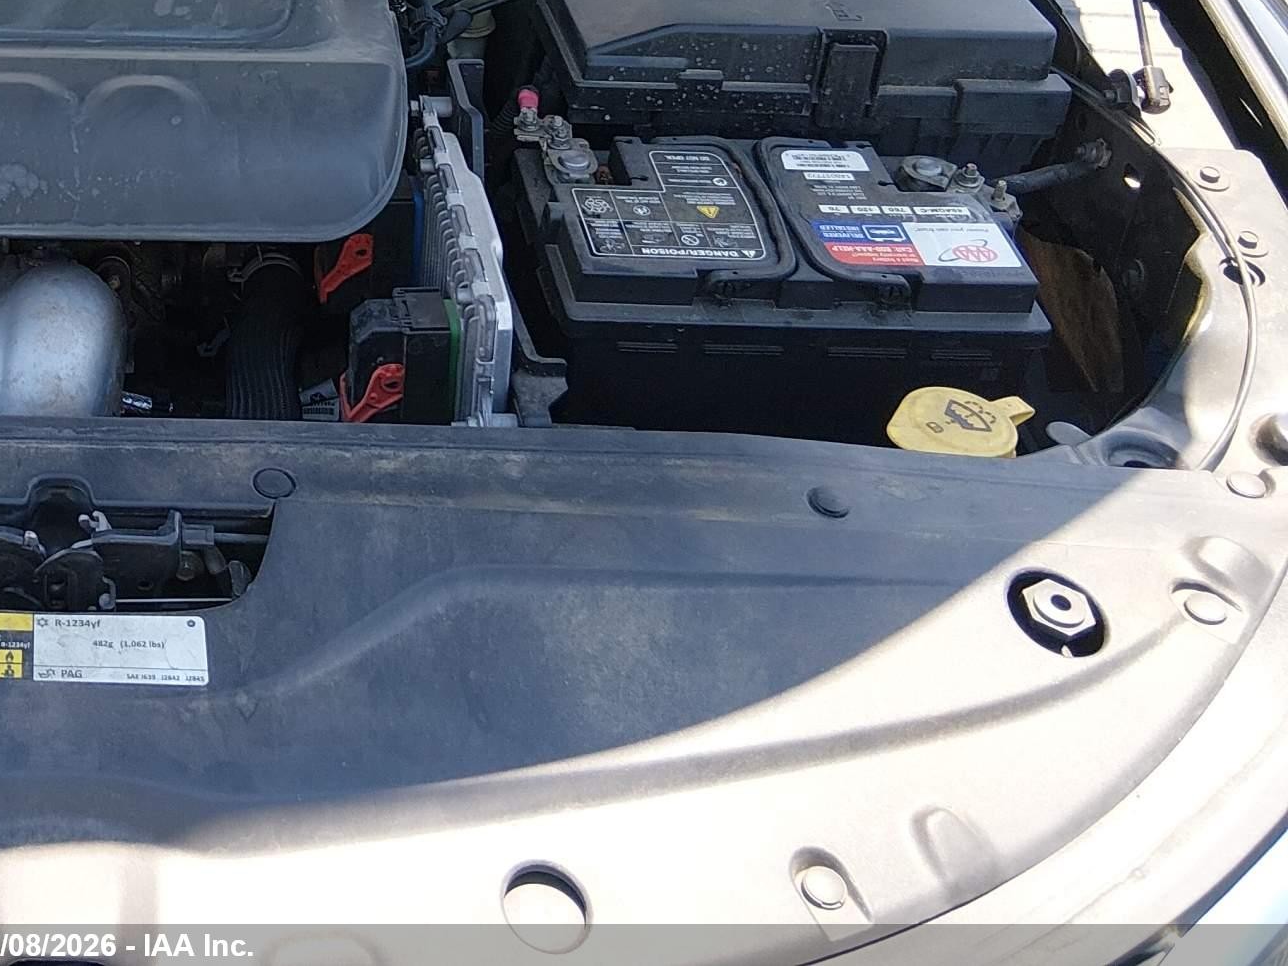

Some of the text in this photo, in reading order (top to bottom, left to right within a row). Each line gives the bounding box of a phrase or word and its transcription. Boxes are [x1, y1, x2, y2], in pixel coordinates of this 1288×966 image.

[641, 247, 738, 258] DANGER/POISON
[955, 245, 993, 261] AAA
[54, 618, 102, 629] R-1234yf
[148, 639, 166, 649] lbs)
[60, 669, 83, 679] PAG
